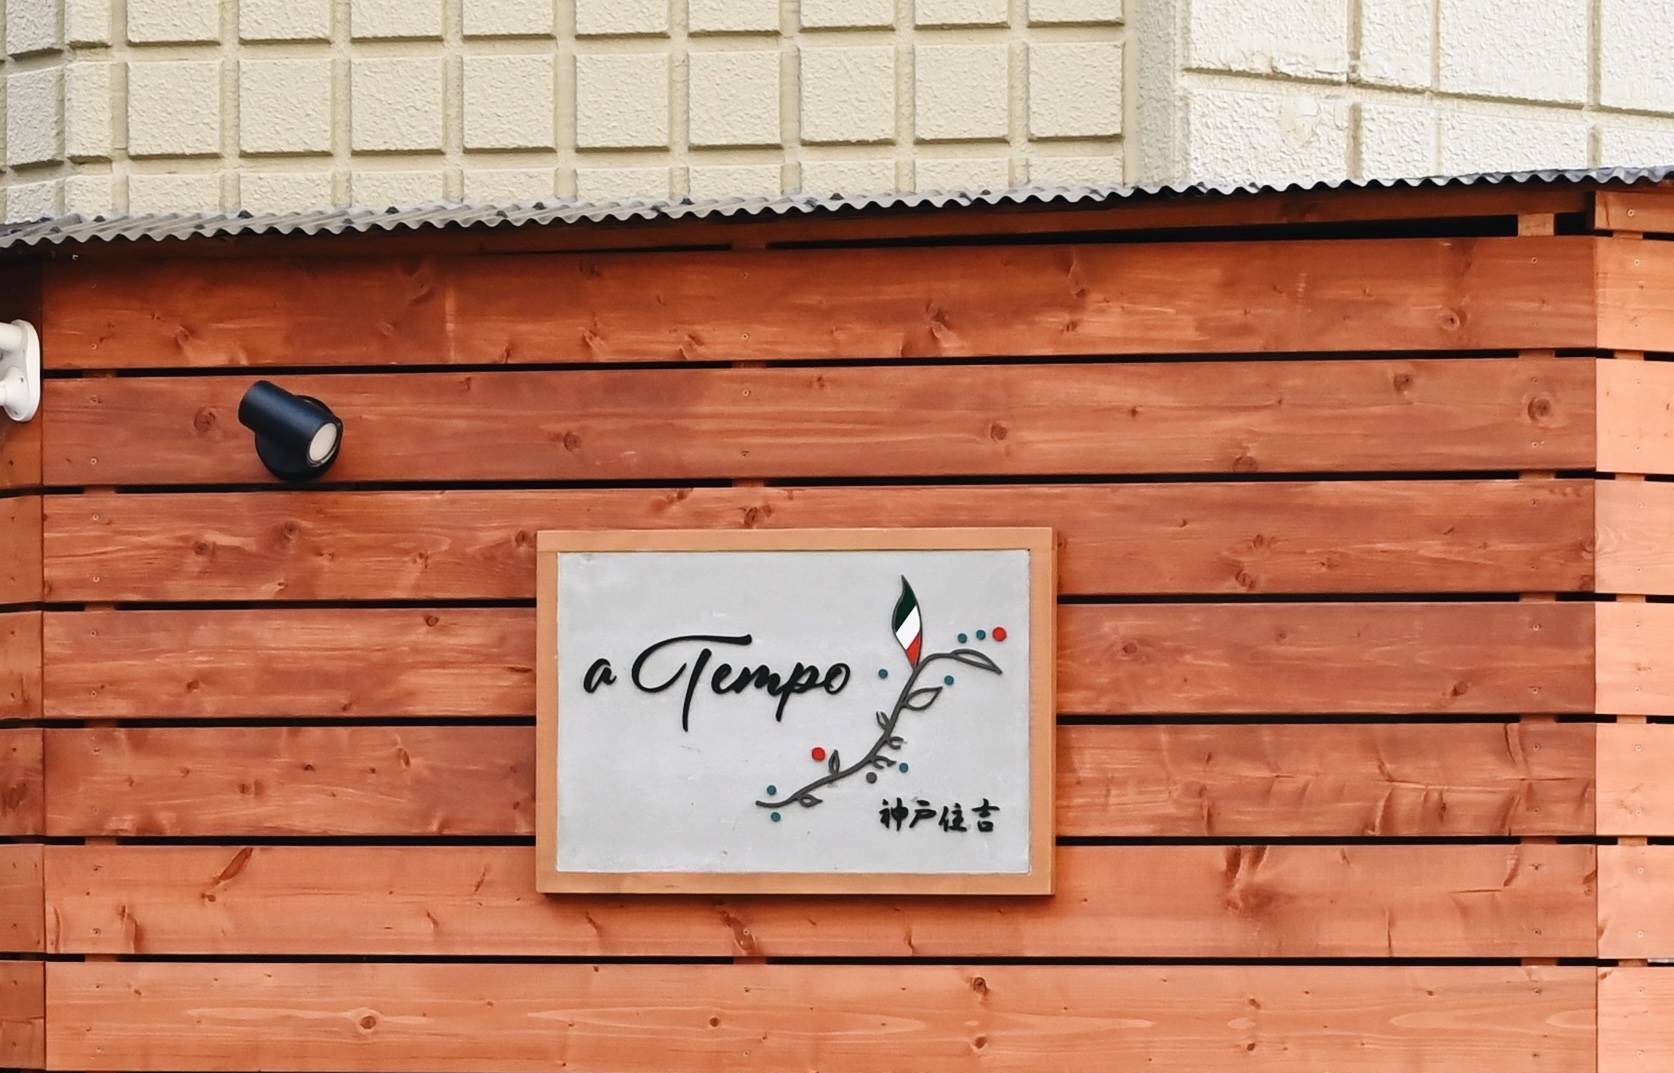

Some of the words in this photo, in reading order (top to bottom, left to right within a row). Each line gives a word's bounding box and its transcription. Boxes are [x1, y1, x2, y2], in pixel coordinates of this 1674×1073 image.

[583, 658, 617, 694] a
[631, 634, 851, 732] Tempo
[878, 797, 1000, 832] 神戸住吉
